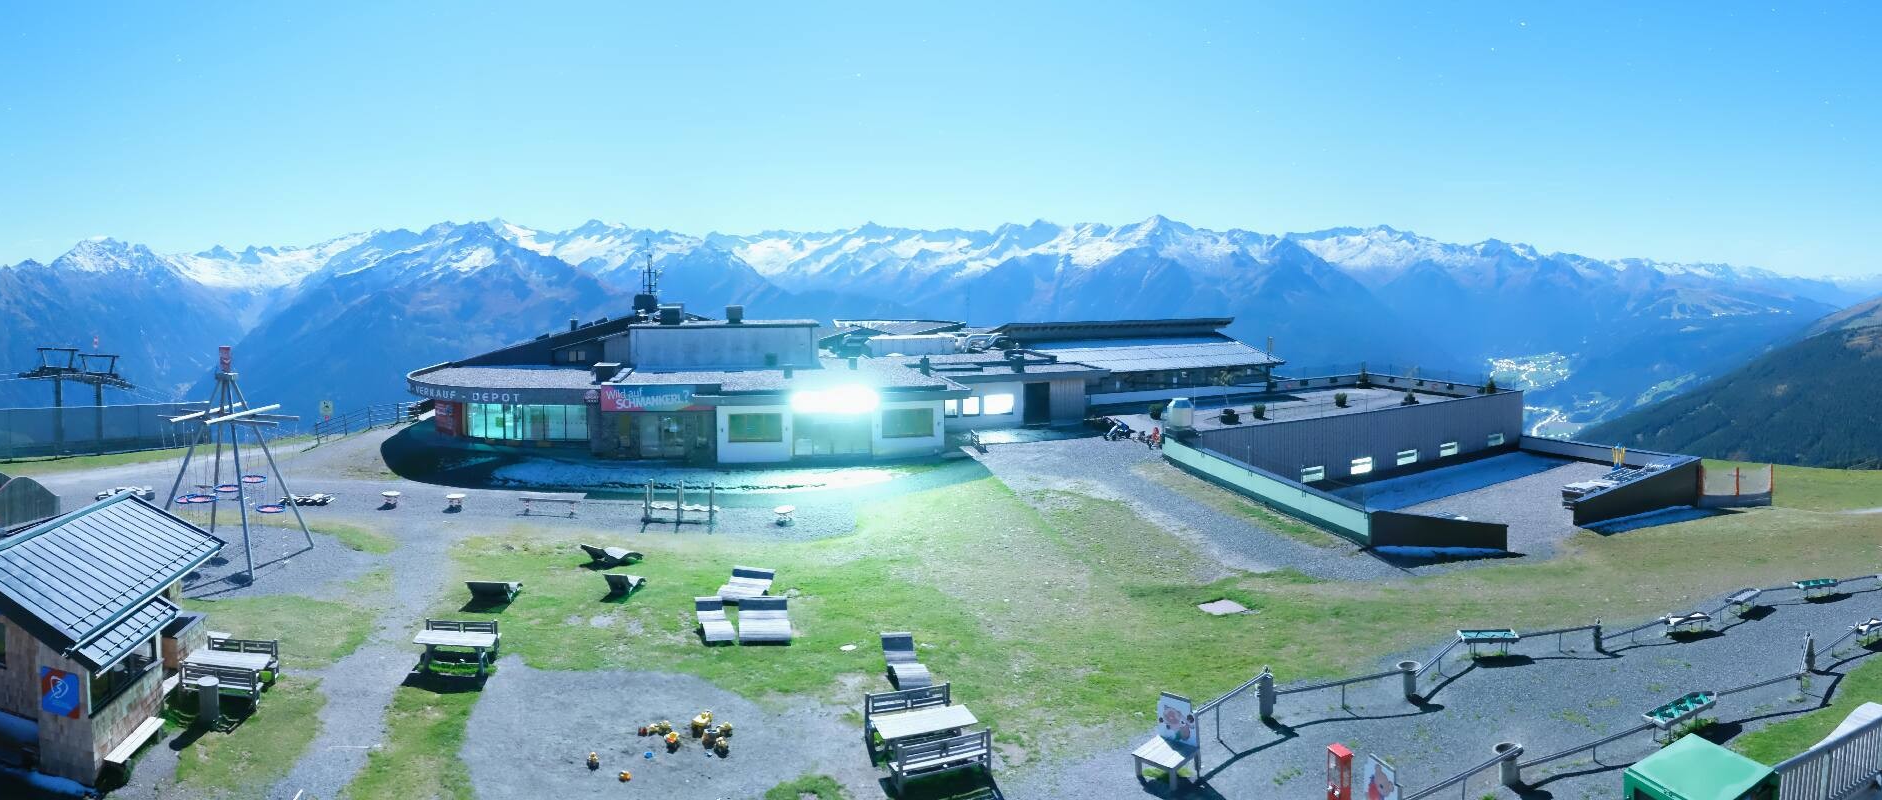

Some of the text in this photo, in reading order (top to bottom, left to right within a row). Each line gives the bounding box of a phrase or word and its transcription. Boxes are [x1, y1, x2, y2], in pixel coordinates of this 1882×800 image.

[415, 384, 521, 402] VERKAUF DEPOT
[605, 389, 626, 400] Wild
[628, 387, 644, 399] auf
